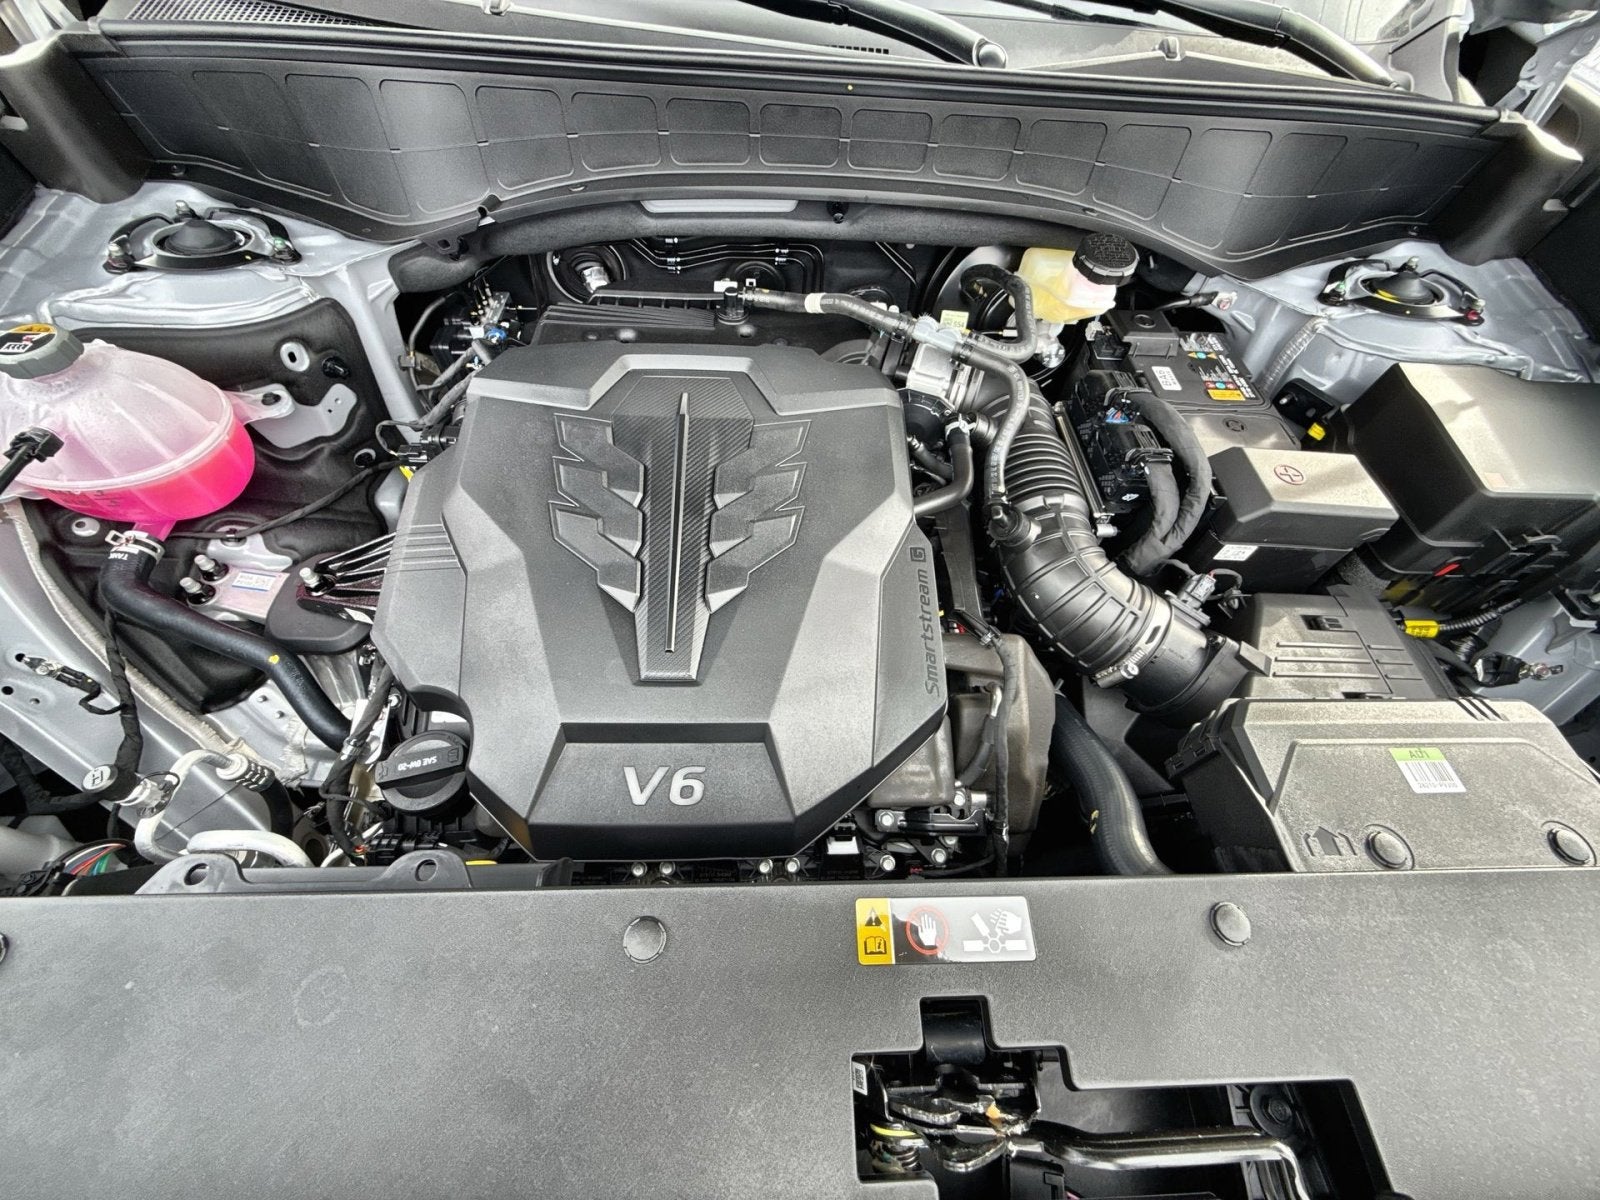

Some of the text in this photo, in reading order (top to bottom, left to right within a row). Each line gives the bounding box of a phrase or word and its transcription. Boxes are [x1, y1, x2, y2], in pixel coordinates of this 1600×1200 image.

[917, 569, 940, 697] Smartstream
[422, 755, 438, 766] SAE
[623, 766, 706, 806] V6
